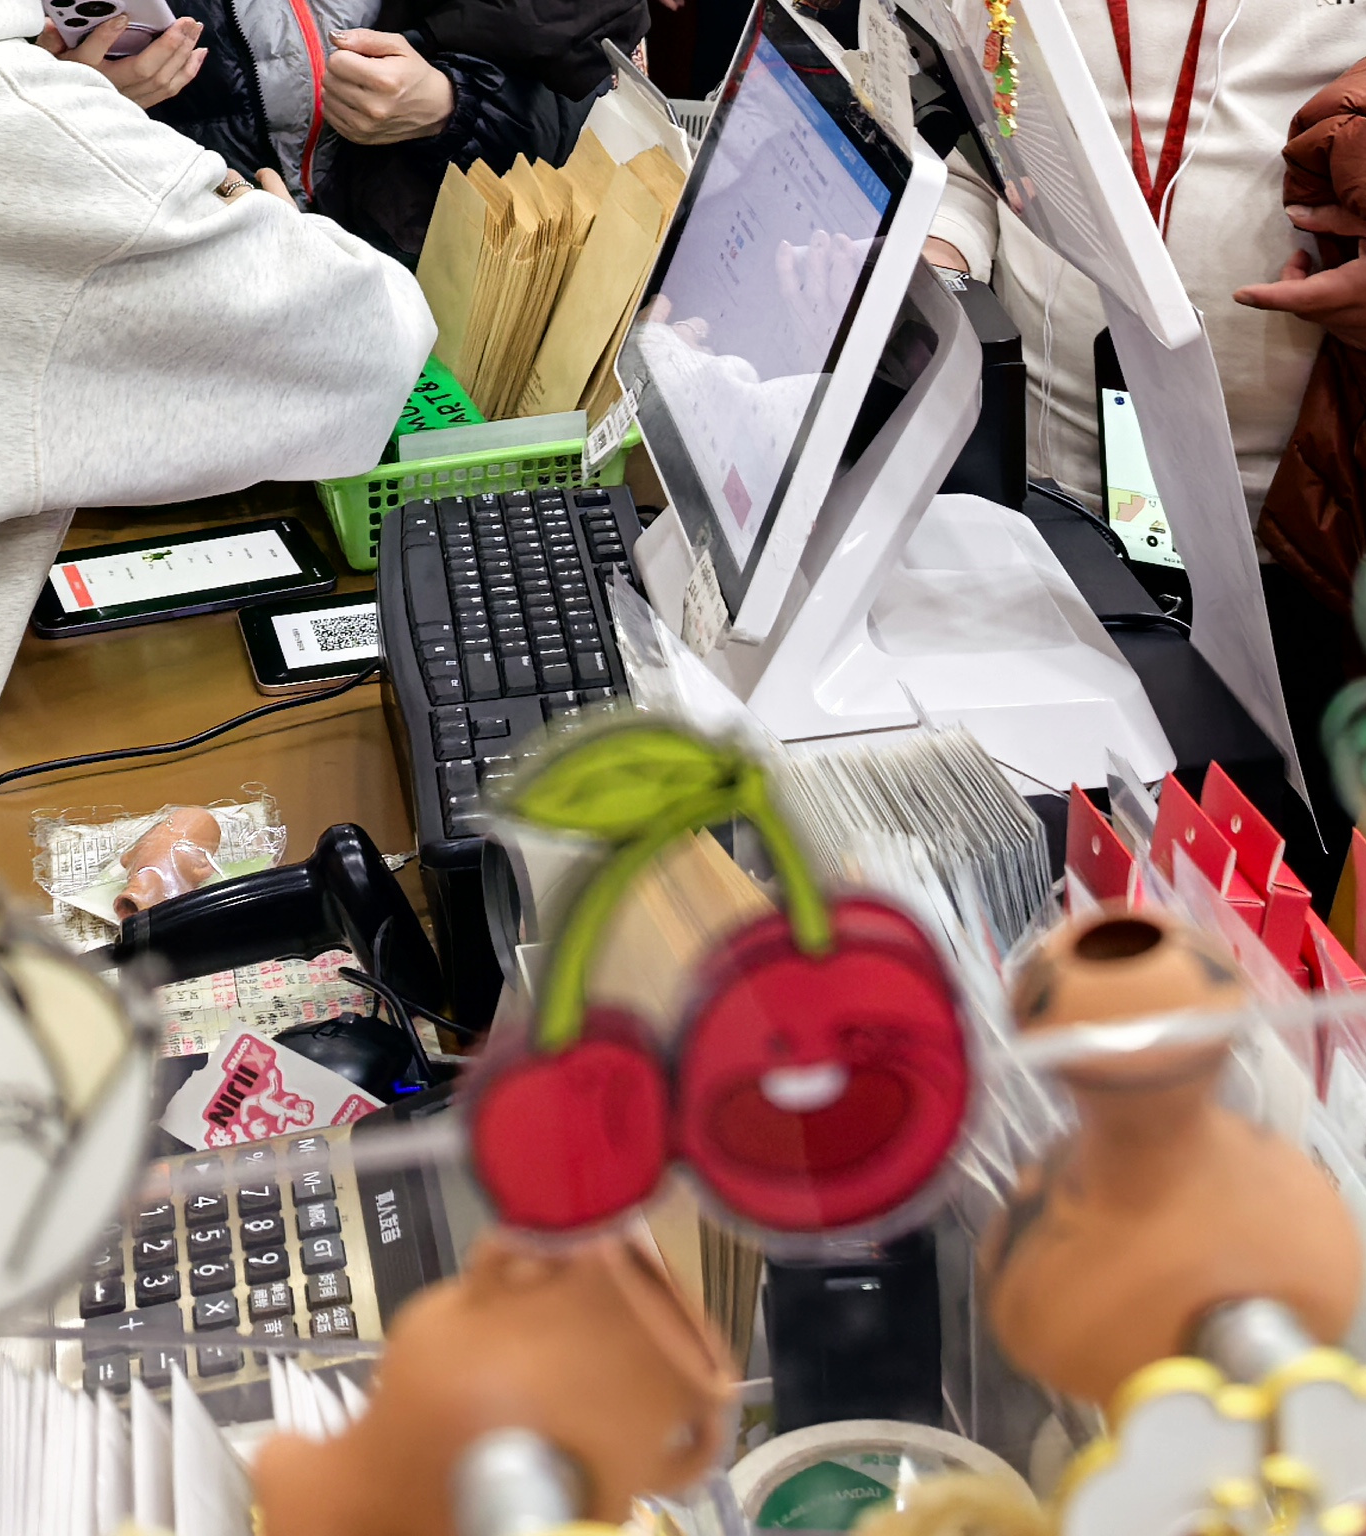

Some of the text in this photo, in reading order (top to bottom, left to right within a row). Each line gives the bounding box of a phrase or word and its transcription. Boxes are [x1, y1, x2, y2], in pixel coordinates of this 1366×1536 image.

[305, 1203, 326, 1228] MRC
[375, 1189, 402, 1244] 真人发音
[312, 1239, 332, 1258] GT
